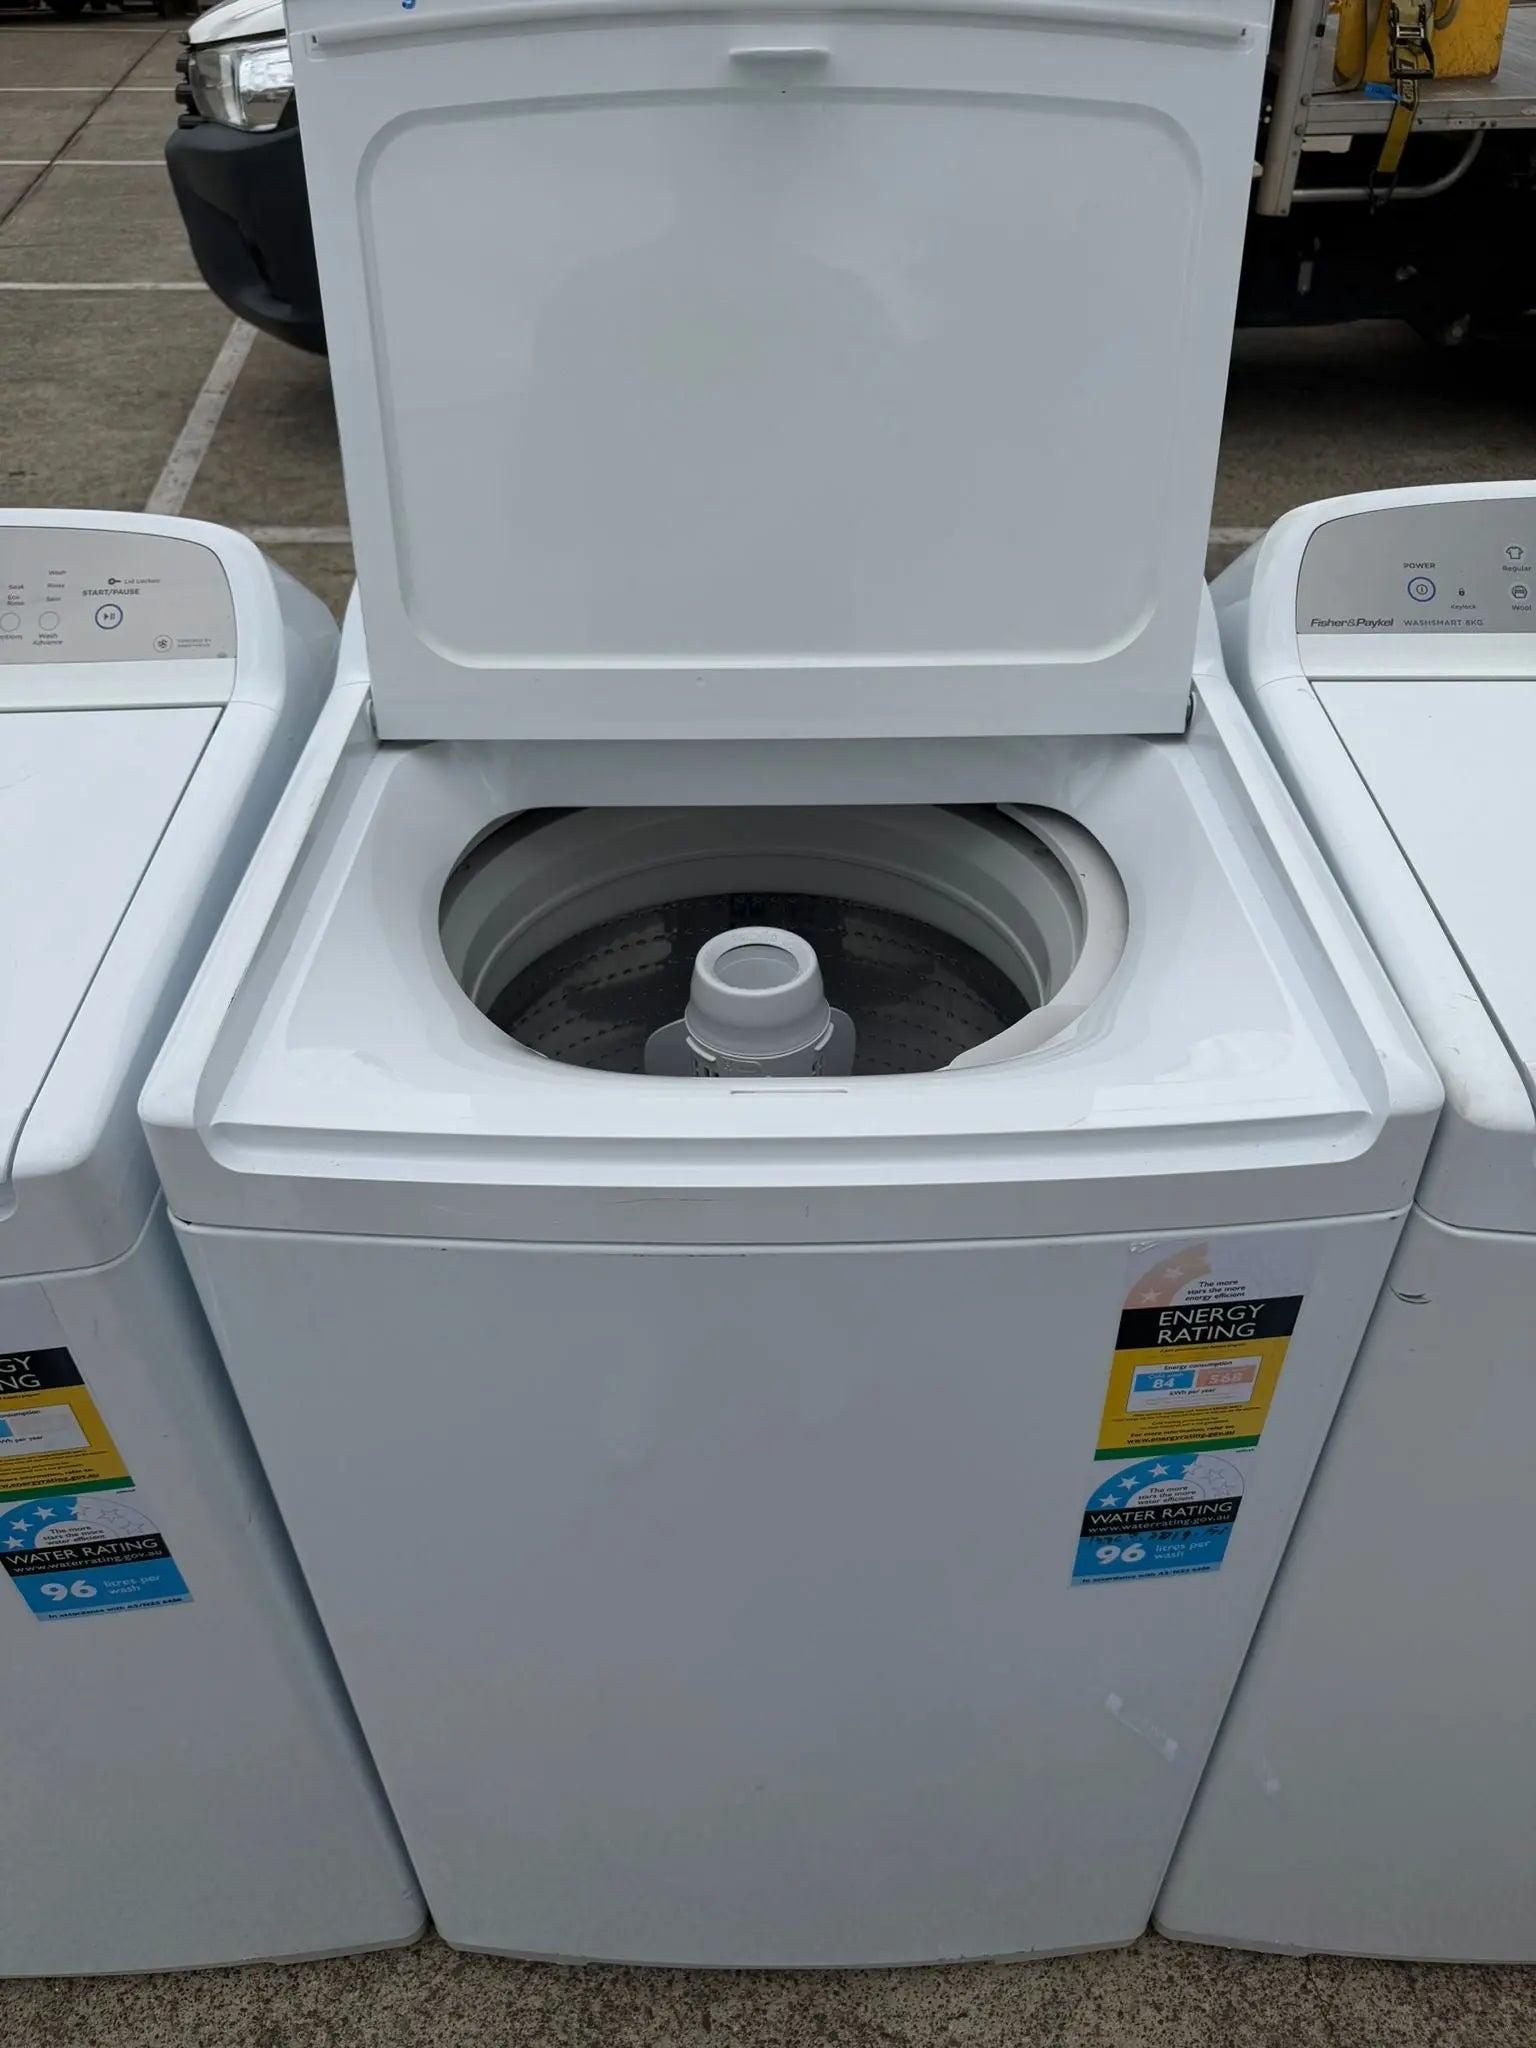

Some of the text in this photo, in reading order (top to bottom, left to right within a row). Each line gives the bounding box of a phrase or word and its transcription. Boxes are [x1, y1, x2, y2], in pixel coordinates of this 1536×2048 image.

[1502, 565, 1532, 573] Regular
[82, 588, 140, 597] START/PAUSE
[1451, 603, 1476, 611] Keylock
[1311, 617, 1394, 629] Fisher&Paykel
[1404, 619, 1462, 627] WASHSMART
[1159, 1304, 1265, 1327] ENERGY
[1157, 1323, 1257, 1344] RATING
[1152, 1378, 1176, 1389] 84
[1090, 1501, 1233, 1525] WATER RATING
[1087, 1514, 1231, 1534] www.waterrating.gov.au
[6, 1538, 158, 1565] WATER RATING
[1096, 1543, 1146, 1565] 96
[1188, 1541, 1211, 1550] per
[1154, 1551, 1184, 1560] wash
[13, 1549, 163, 1574] www.waterrating.gov.au
[40, 1574, 161, 1601] 96 litres per
[109, 1585, 140, 1595] wash
